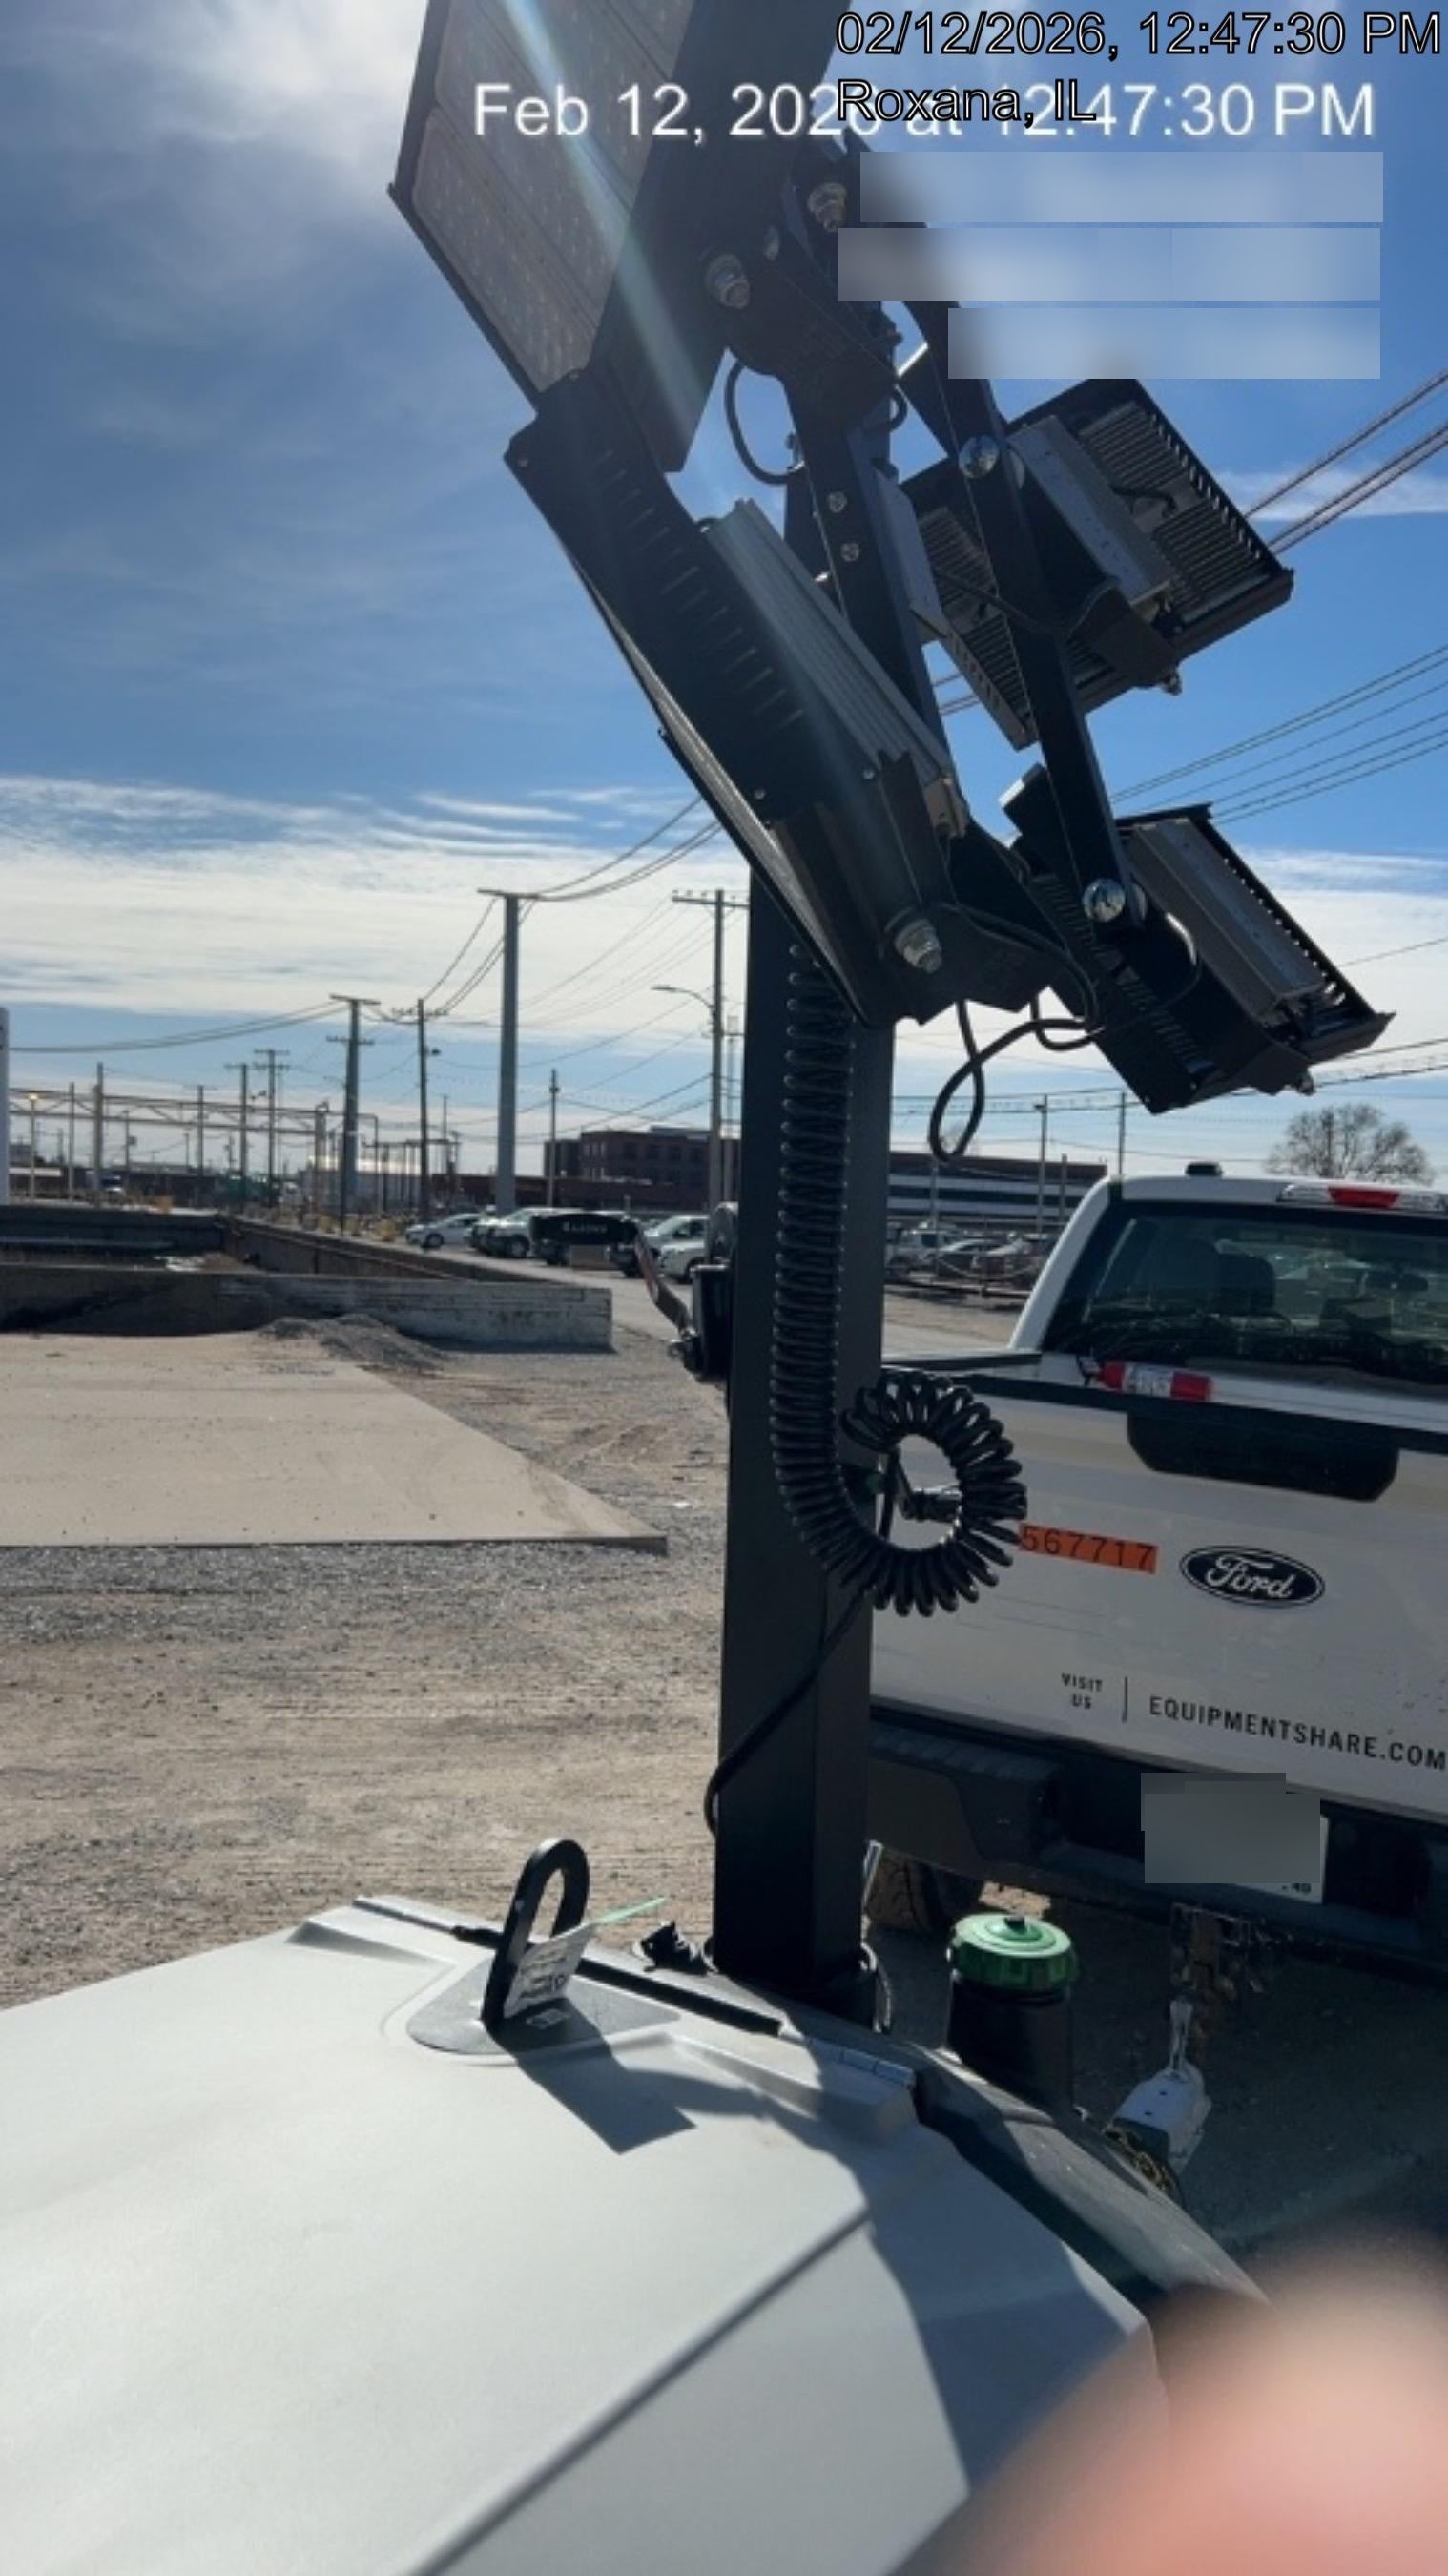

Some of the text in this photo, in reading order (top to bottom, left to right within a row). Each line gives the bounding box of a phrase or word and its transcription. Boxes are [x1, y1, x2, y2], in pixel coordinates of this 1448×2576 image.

[1021, 1527, 1156, 1571] 567717
[1206, 1553, 1295, 1600] Ford
[1061, 1672, 1103, 1693] VISIT
[1071, 1693, 1092, 1710] US
[1148, 1694, 1447, 1772] EQUIPMENTSHARE.COM
